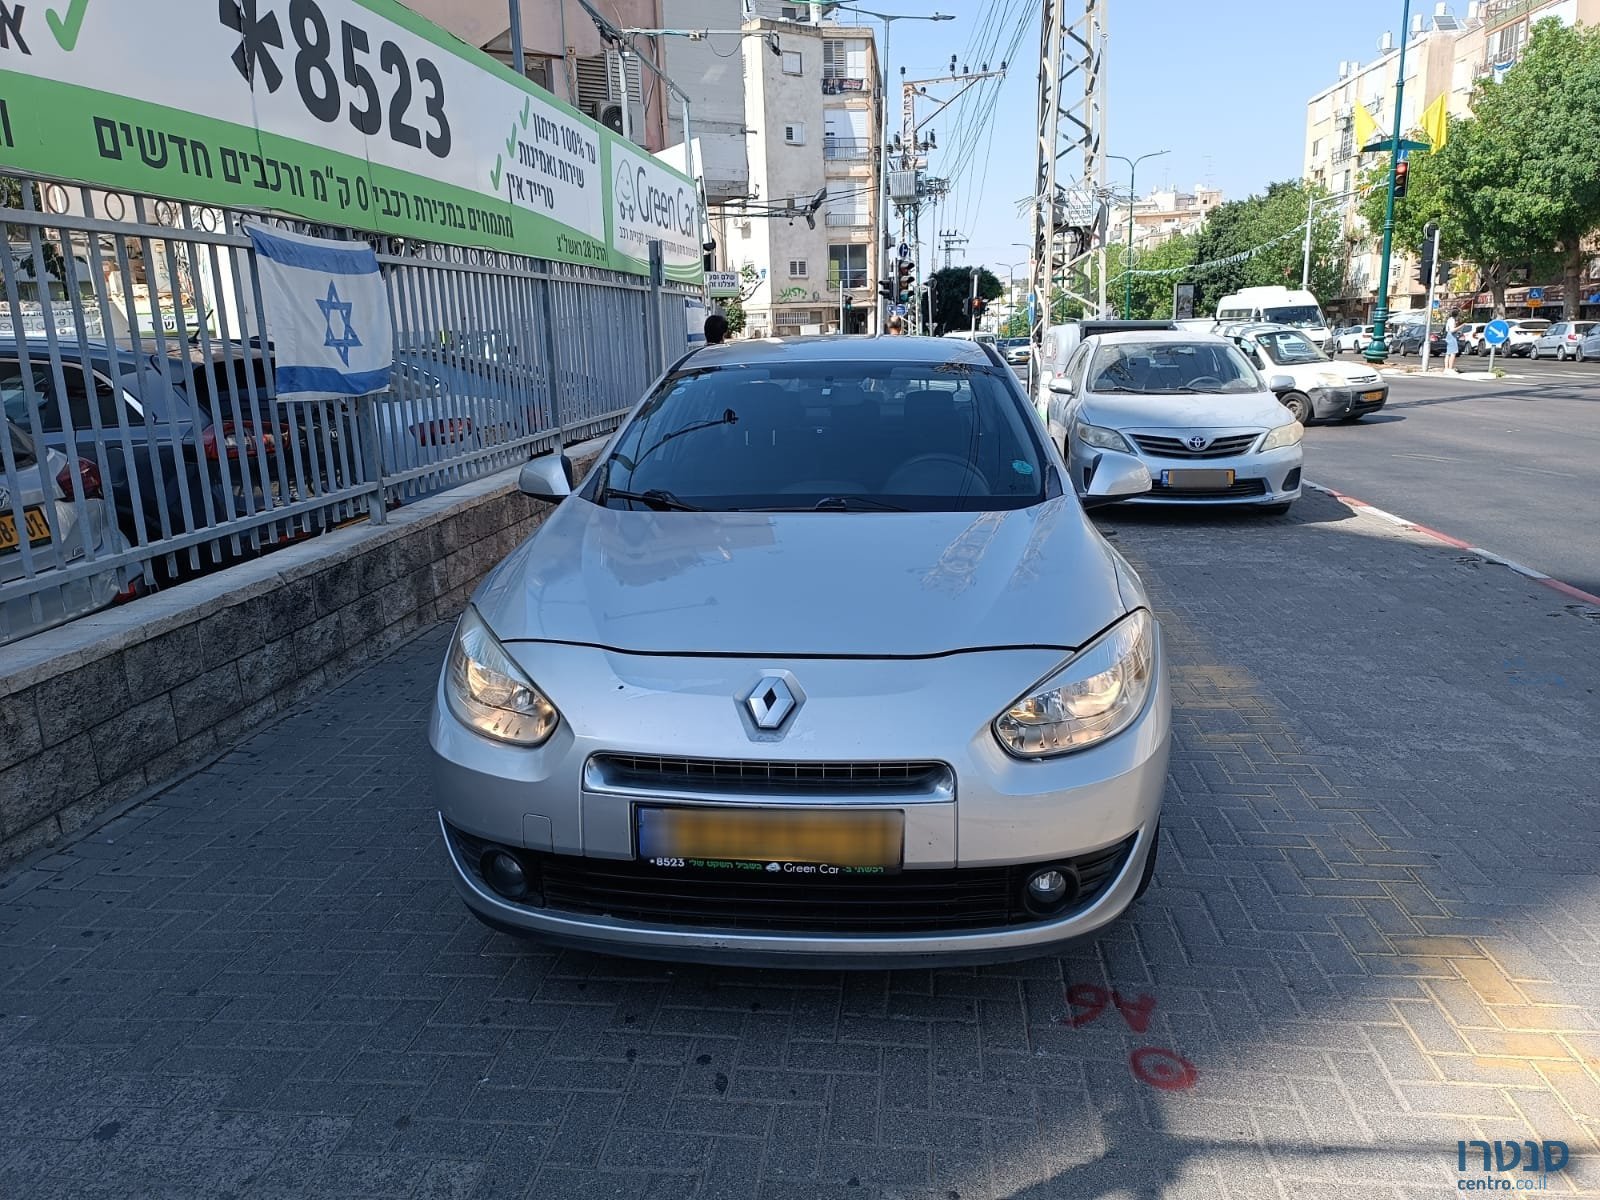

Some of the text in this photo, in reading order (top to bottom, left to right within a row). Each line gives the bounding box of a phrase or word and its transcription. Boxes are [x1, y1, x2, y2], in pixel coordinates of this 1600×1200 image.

[93, 116, 213, 179] חדשים
[533, 113, 596, 164] עד 100% מימון
[220, 147, 305, 197] ורכבים
[518, 140, 584, 188] שירות ואמינות
[356, 176, 369, 211] 0
[373, 184, 411, 219] רכבי
[506, 172, 554, 209] טרייד אין
[637, 166, 694, 238] Green Car
[414, 195, 466, 229] במכירת
[468, 207, 514, 238] מתמחים
[583, 240, 591, 258] 28
[592, 241, 607, 262] הרצל
[783, 862, 817, 874] Green
[819, 864, 840, 875] Car
